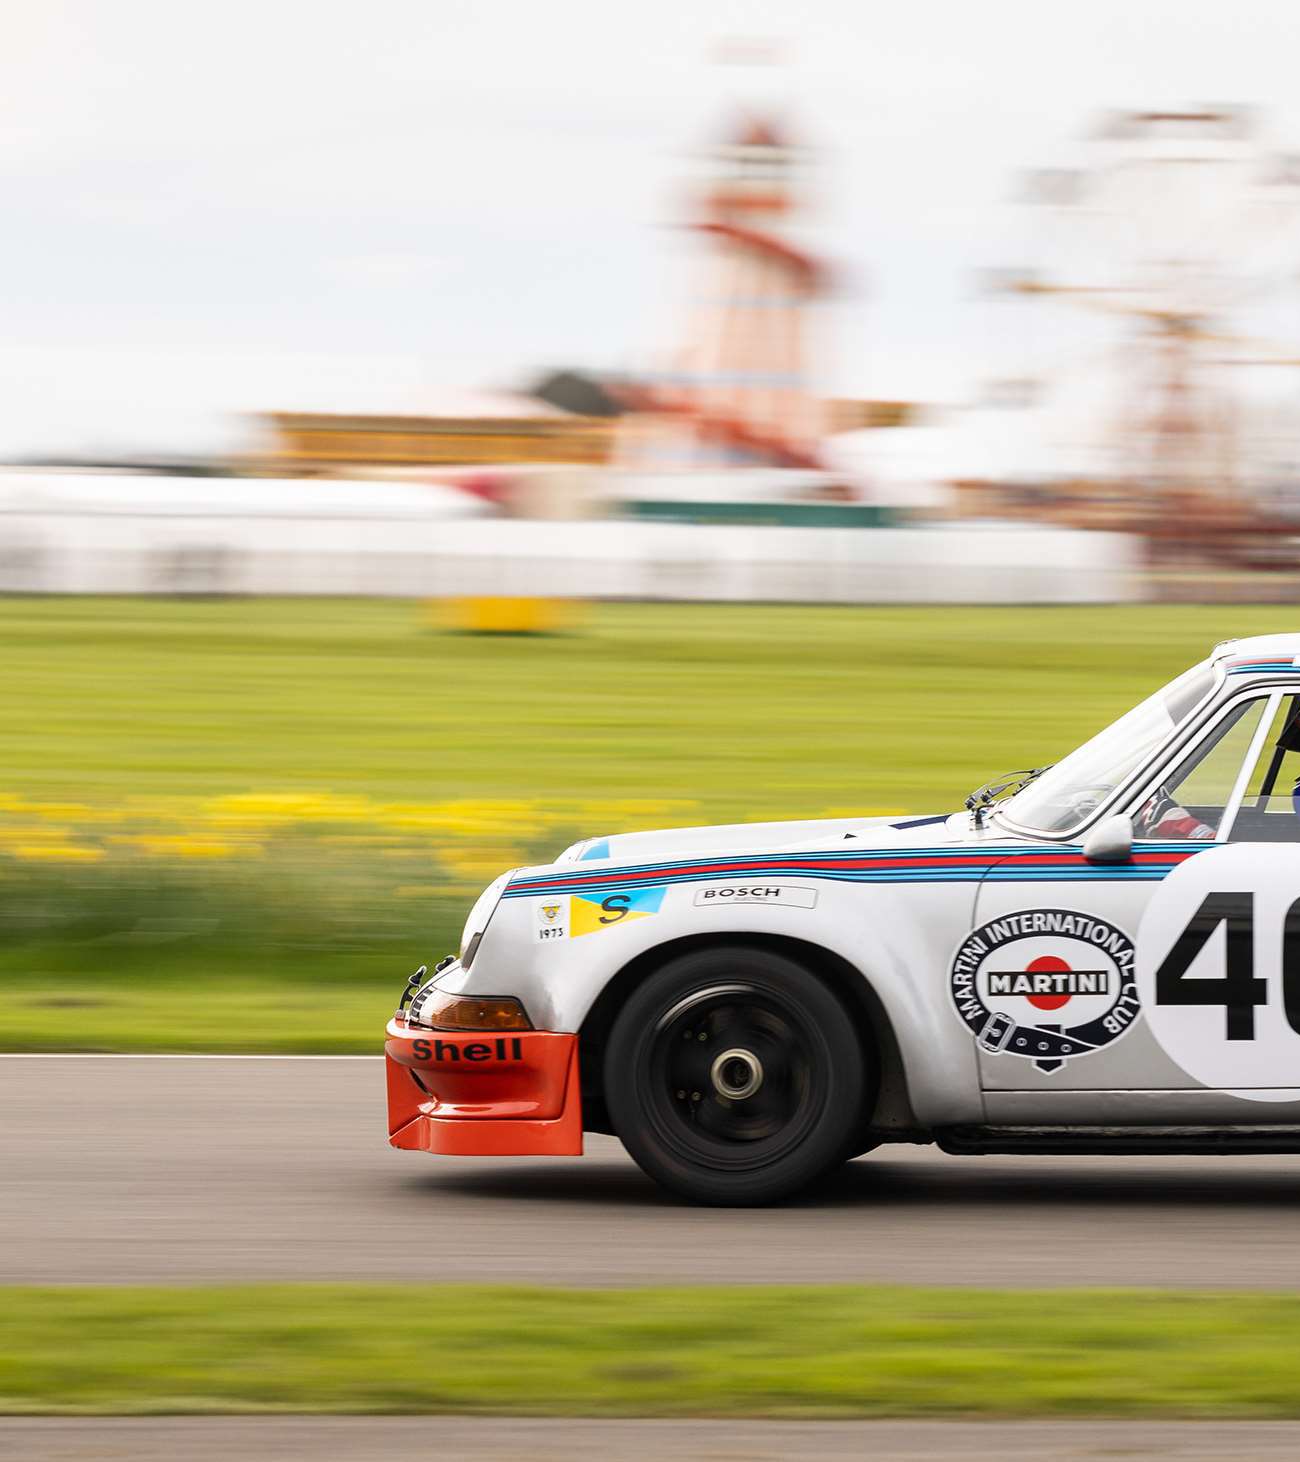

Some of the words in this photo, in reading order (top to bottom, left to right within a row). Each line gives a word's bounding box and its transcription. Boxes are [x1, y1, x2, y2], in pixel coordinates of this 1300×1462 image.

[704, 887, 780, 899] BOSCH
[599, 894, 632, 924] S
[539, 927, 564, 940] 1973
[953, 936, 989, 1021] MARTINI
[984, 913, 1136, 977] INTERNATIONAL
[1102, 982, 1141, 1034] CLUB
[989, 974, 1107, 993] MARTINI
[412, 1038, 522, 1061] Shell
